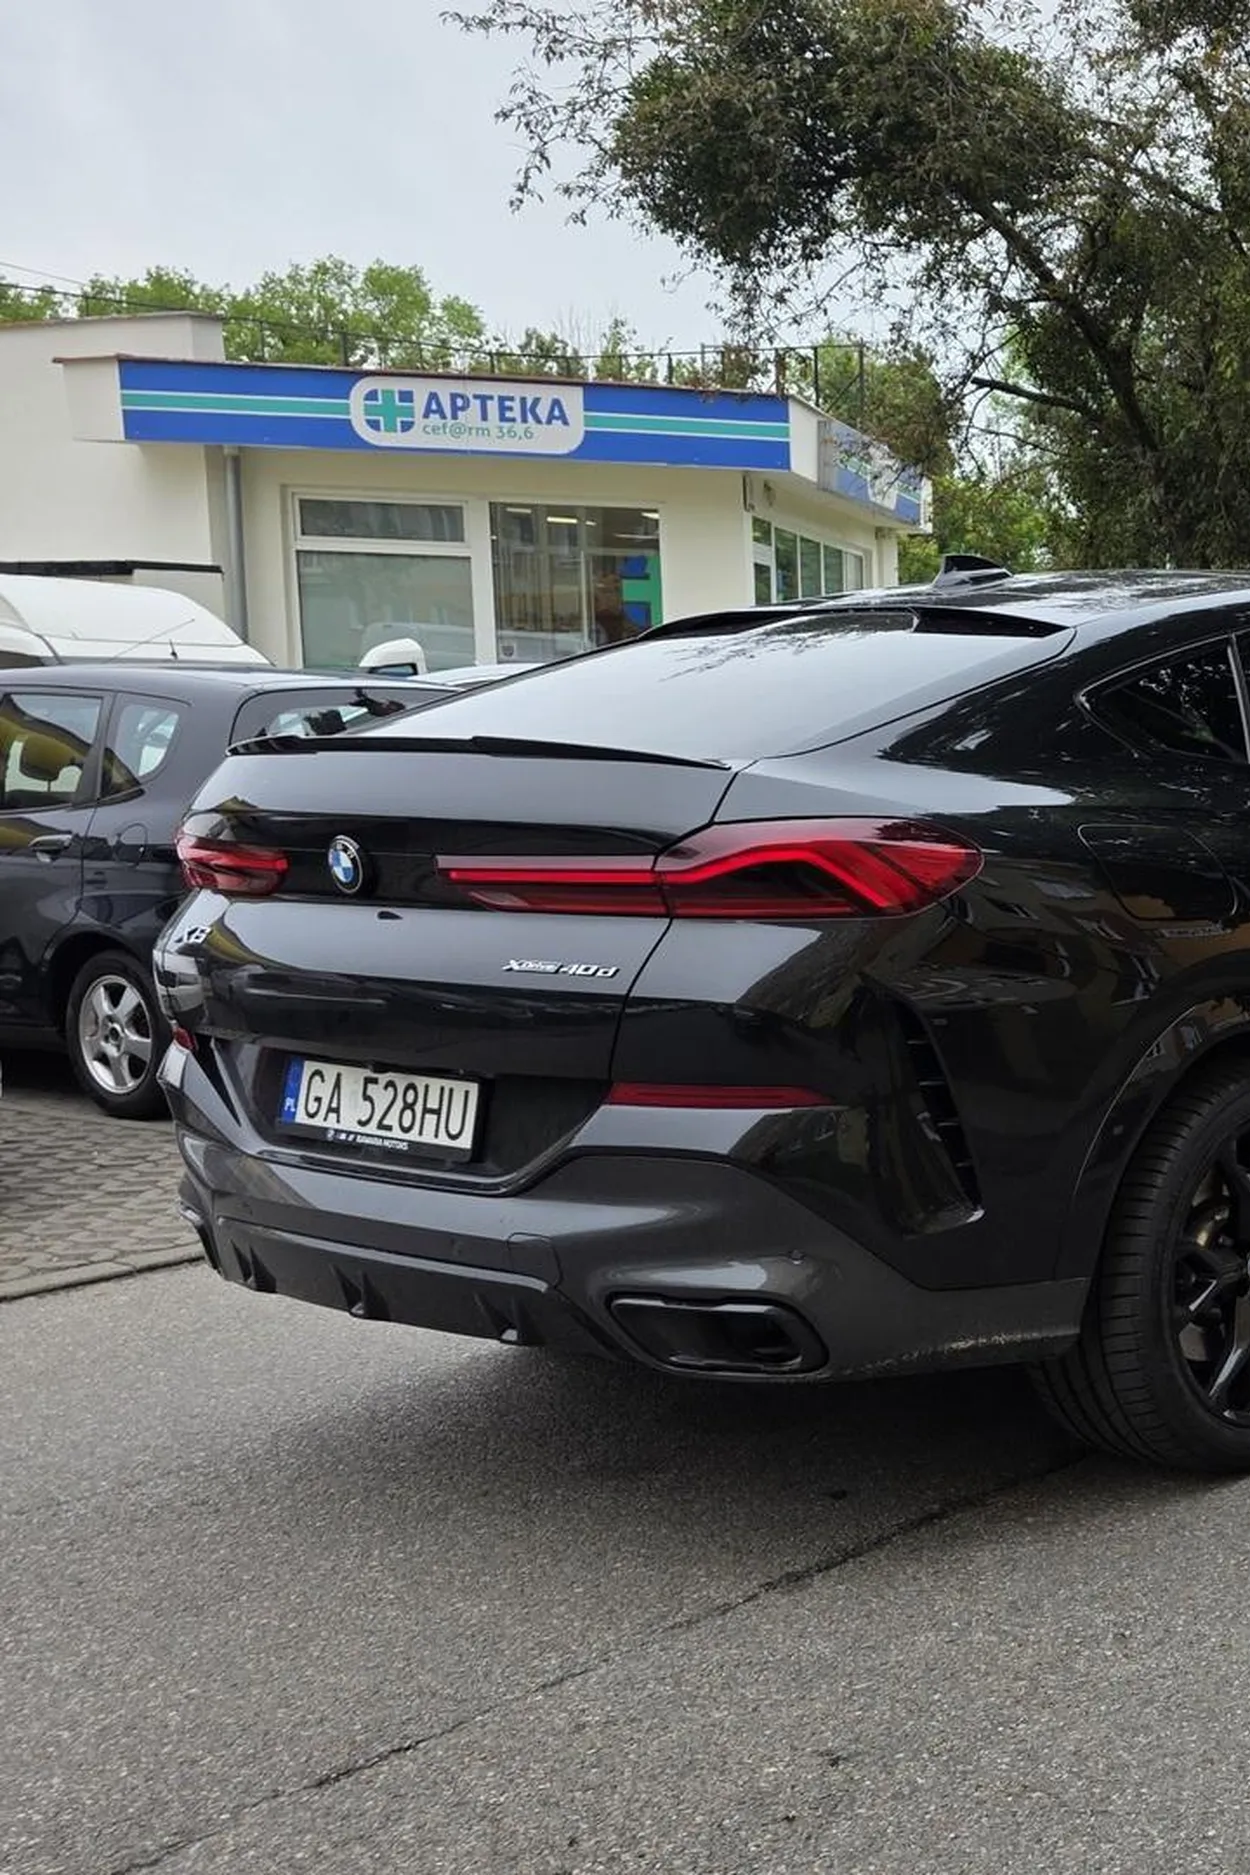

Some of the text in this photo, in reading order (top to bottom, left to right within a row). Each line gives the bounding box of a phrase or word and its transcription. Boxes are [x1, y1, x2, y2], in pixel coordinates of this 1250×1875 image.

[422, 391, 570, 427] APTEKA
[496, 425, 535, 441] 36,6
[284, 1097, 296, 1112] PL
[304, 1069, 470, 1141] GA 528HU
